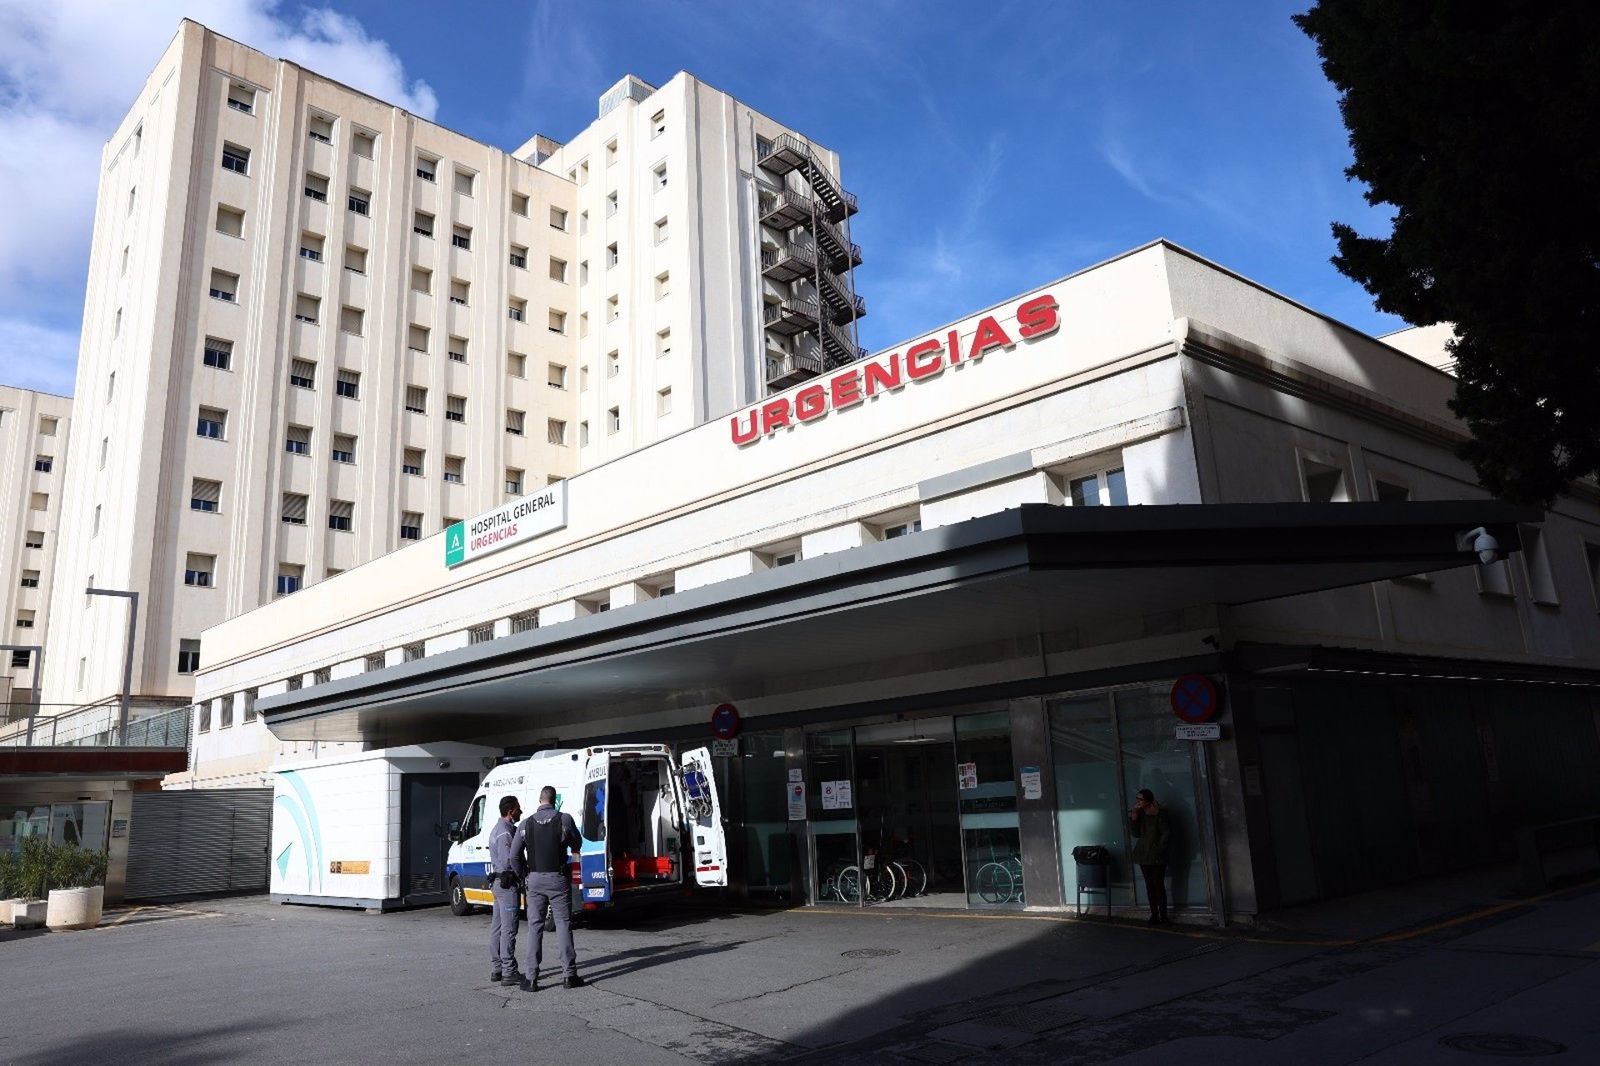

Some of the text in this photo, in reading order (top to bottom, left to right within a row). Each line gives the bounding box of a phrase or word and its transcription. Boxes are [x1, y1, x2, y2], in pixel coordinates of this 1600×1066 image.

[731, 294, 1061, 445] URGENCIAS
[470, 492, 556, 536] HOSPITAL GENERAL
[470, 523, 518, 551] URGENCIAS
